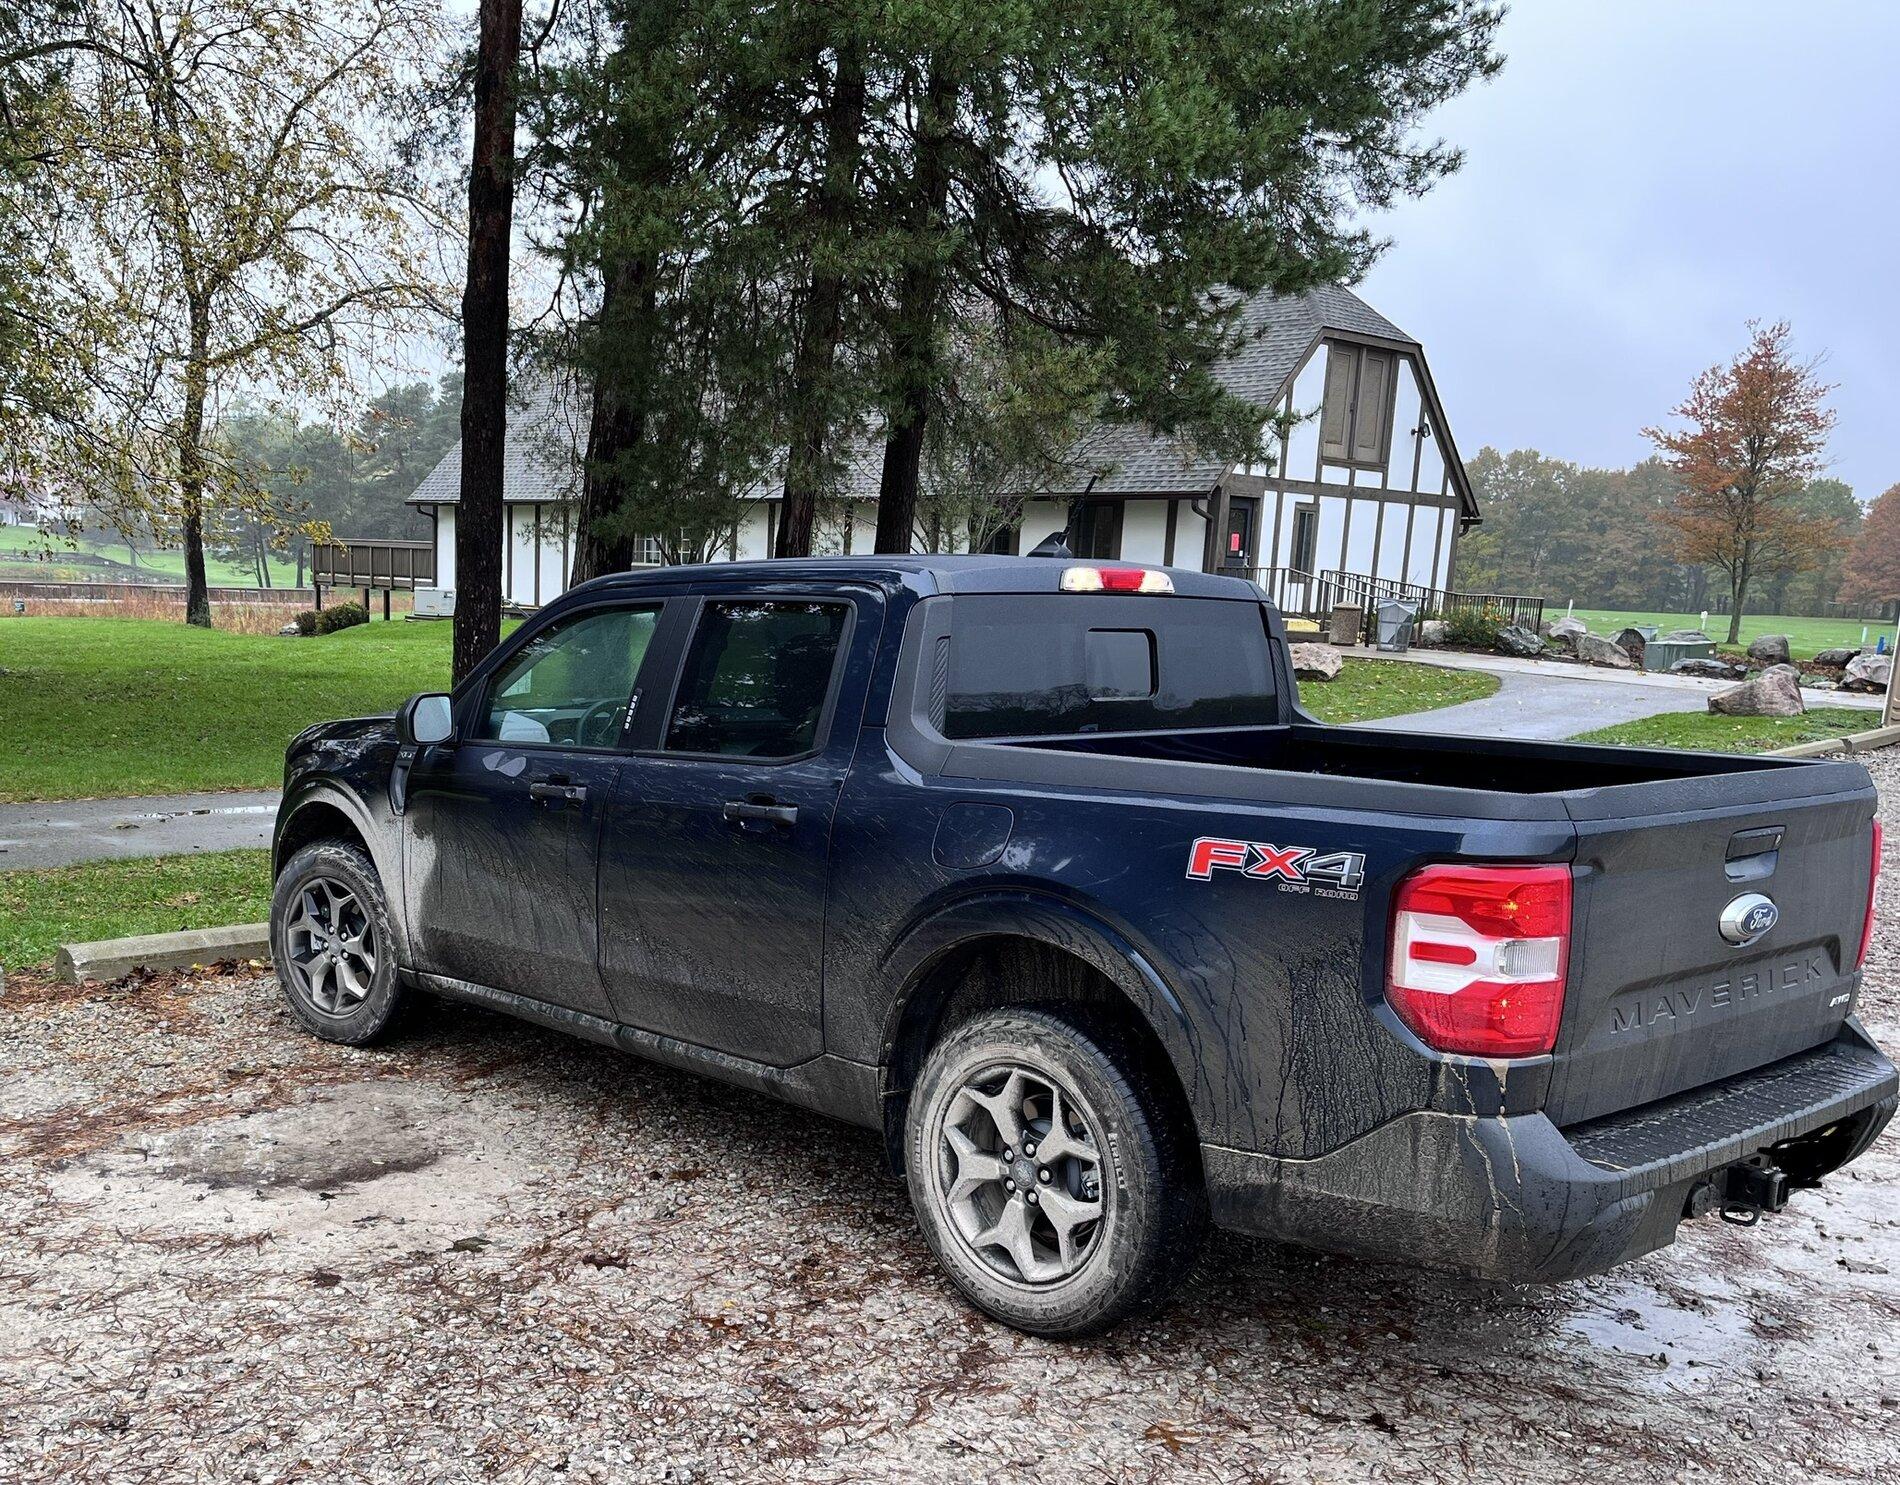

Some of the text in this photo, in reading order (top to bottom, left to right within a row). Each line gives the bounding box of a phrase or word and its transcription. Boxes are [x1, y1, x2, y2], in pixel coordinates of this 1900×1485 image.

[1186, 836, 1366, 892] FX4
[1278, 883, 1359, 900] OFF ROAD
[1750, 908, 1773, 930] Ford
[1609, 955, 1823, 1035] MAVERICK
